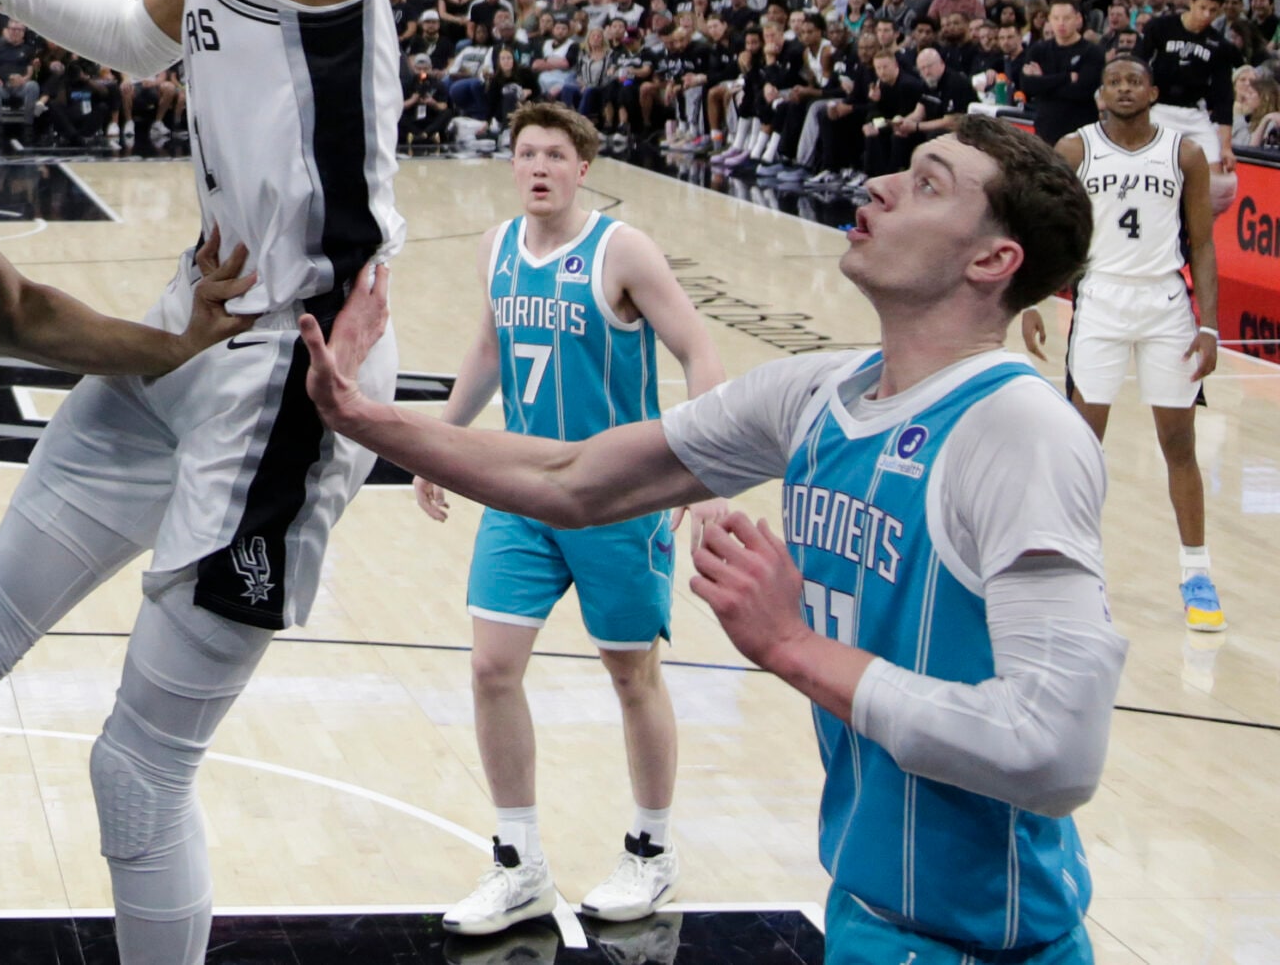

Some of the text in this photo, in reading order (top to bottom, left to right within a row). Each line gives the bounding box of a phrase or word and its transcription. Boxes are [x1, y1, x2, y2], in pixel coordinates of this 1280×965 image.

[1118, 208, 1141, 239] 4
[493, 296, 587, 336] HORNETS
[513, 342, 554, 404] 7
[783, 483, 904, 585] HORNETS
